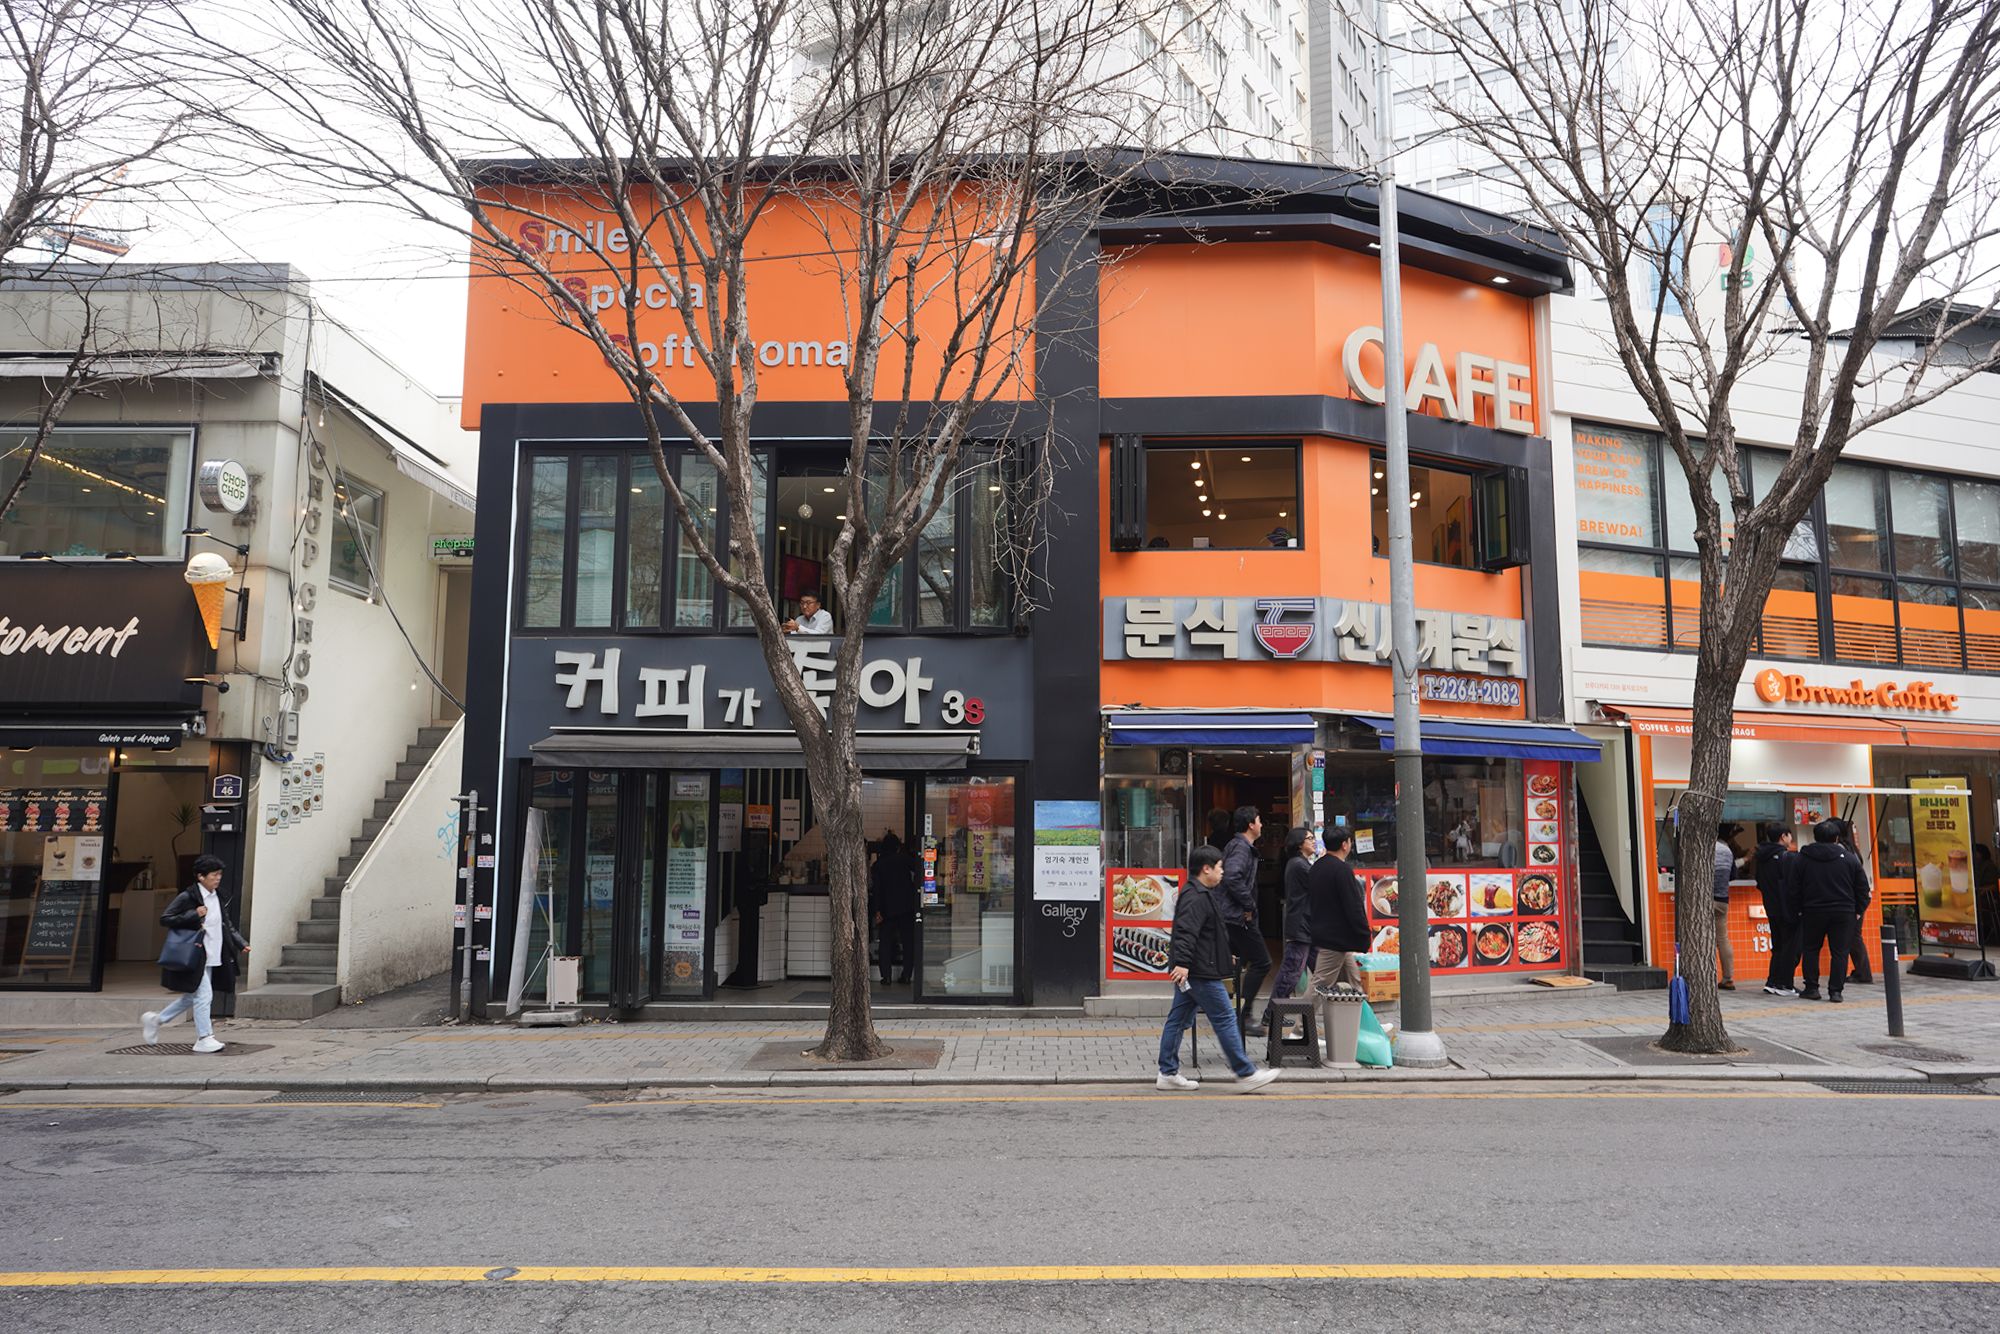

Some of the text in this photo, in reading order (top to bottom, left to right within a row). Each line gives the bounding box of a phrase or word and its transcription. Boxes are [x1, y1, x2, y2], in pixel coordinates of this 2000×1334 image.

[519, 220, 630, 253] Smile
[563, 276, 704, 315] Specia
[731, 340, 848, 368] oma
[1342, 326, 1534, 434] CAFE
[1576, 433, 1622, 449] MAKING
[1577, 448, 1607, 461] YOUR
[1577, 464, 1628, 479] BREW OF
[223, 472, 246, 489] CHOP
[222, 484, 245, 500] CHOP
[1579, 519, 1643, 537] BREWDA!
[1124, 598, 1239, 659] 분식
[1638, 723, 1669, 732] COFFEE
[221, 786, 233, 795] 46
[1041, 903, 1087, 921] Gallery
